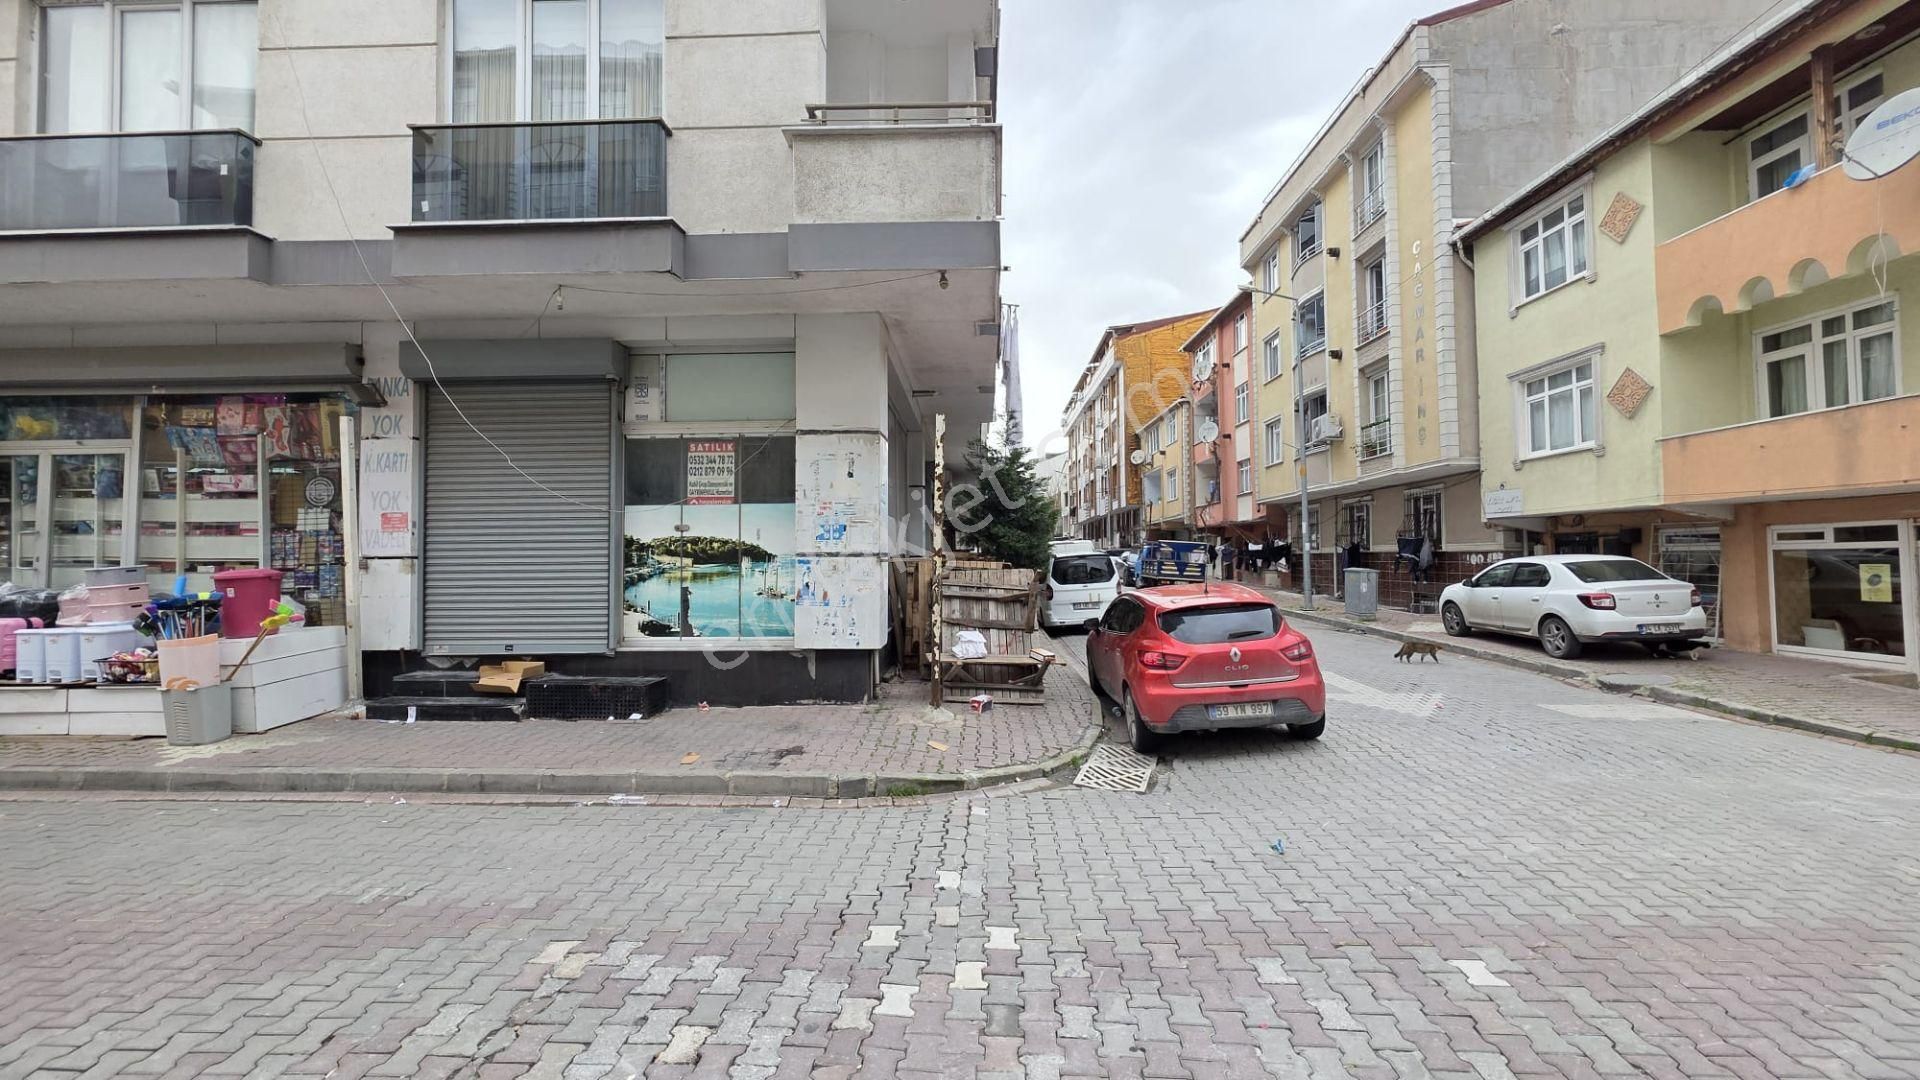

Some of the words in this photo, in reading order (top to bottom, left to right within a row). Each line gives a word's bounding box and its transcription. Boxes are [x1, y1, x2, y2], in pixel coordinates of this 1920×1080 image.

[367, 376, 410, 397] ANKA
[372, 414, 403, 435] YOK
[690, 443, 734, 451] SATILIK
[689, 455, 704, 465] 0532
[717, 455, 726, 465] 78
[689, 467, 703, 476] 0212
[716, 467, 726, 476] 09
[371, 491, 401, 511] YOK
[1224, 664, 1249, 672] CLIO
[1216, 705, 1229, 716] 59
